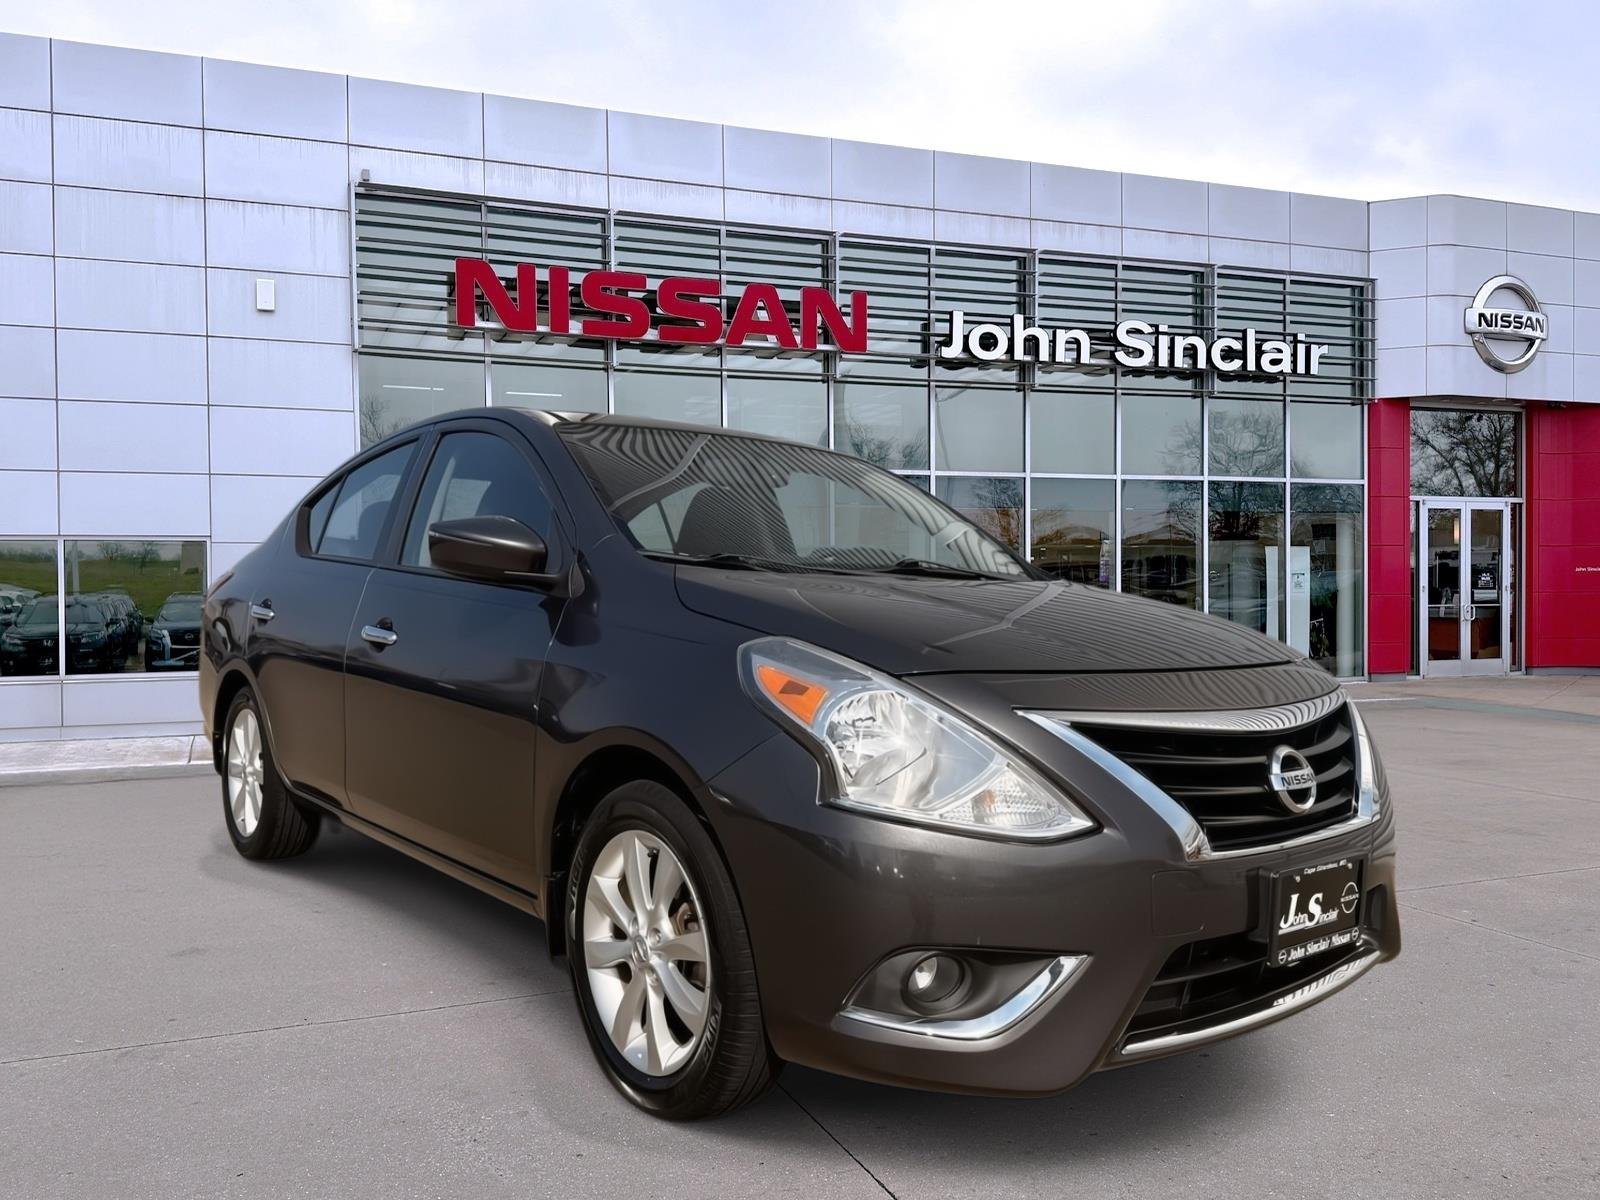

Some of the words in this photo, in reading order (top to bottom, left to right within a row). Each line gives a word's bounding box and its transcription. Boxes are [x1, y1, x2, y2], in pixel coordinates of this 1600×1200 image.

[454, 256, 868, 354] NISSAN
[1477, 311, 1546, 333] NISSAN
[940, 310, 1091, 364] John
[1114, 318, 1330, 376] Sinclair
[1288, 946, 1305, 961] John
